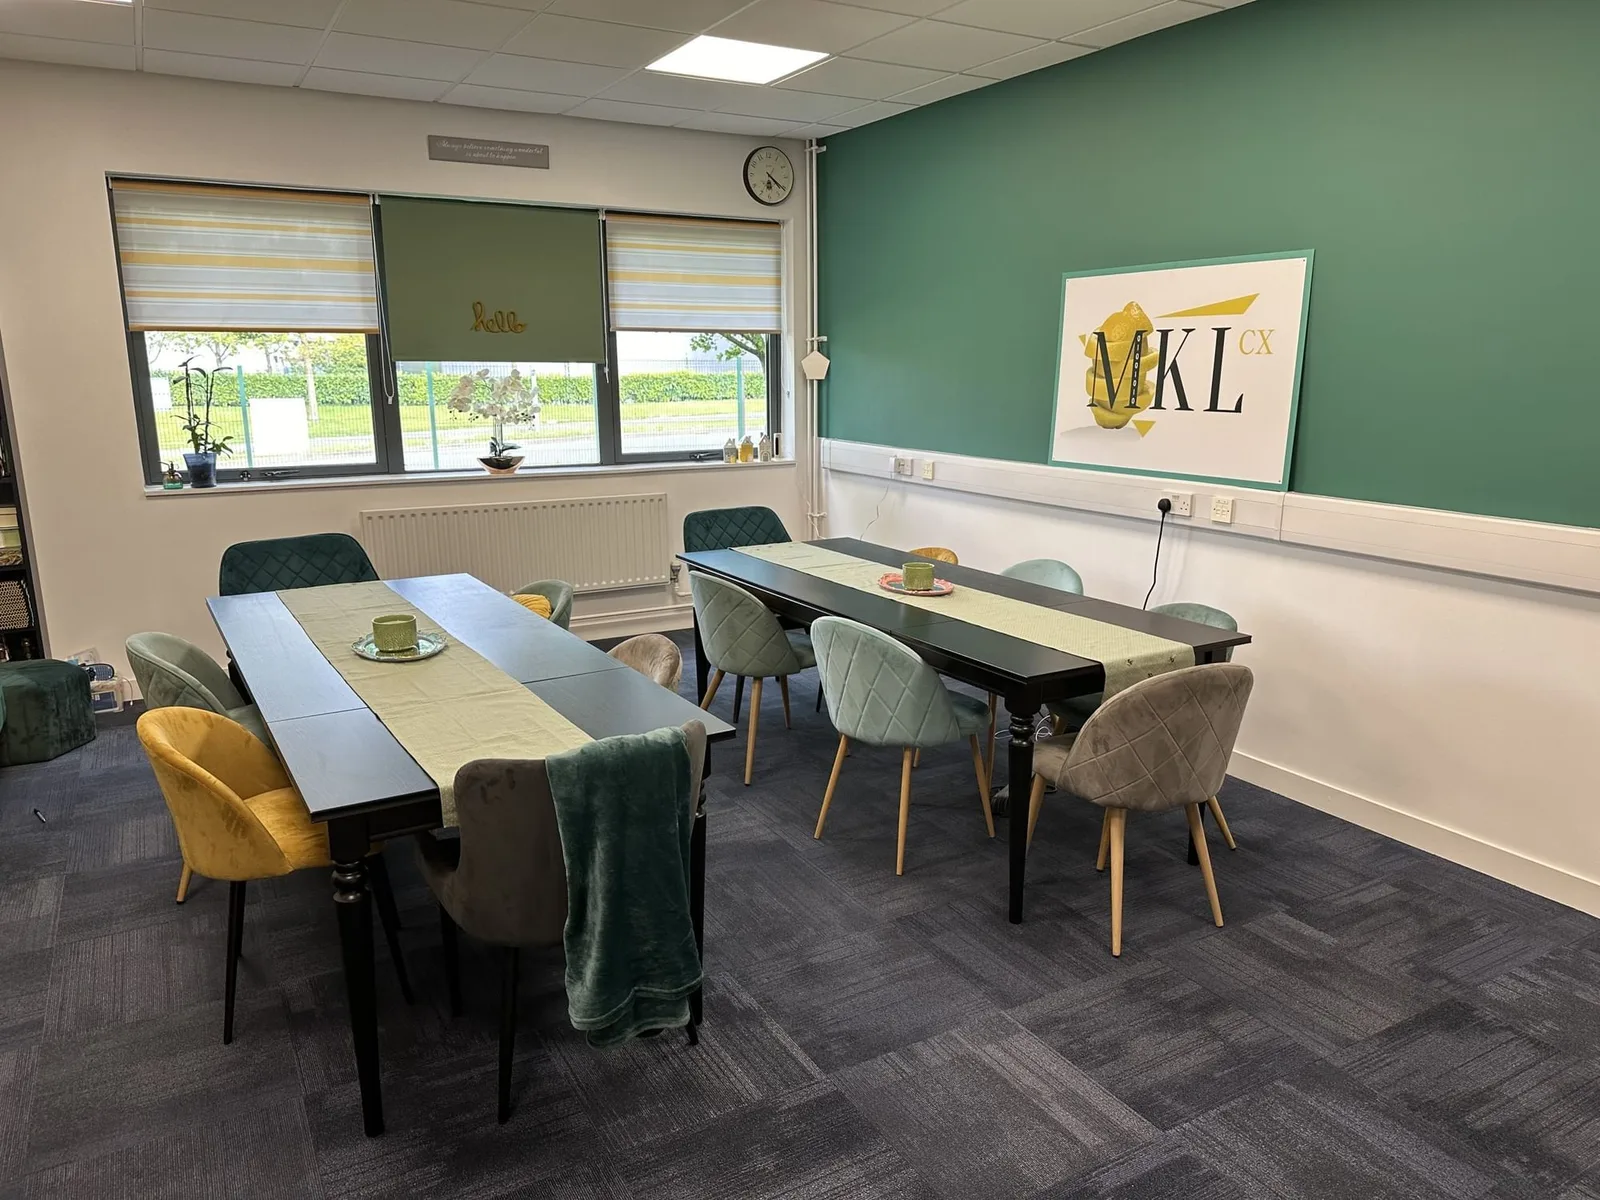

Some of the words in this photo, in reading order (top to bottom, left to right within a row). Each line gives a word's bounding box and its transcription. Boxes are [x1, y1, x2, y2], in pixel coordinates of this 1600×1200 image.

[469, 301, 527, 333] hello
[1086, 326, 1244, 413] MKL
[1239, 329, 1275, 355] CX
